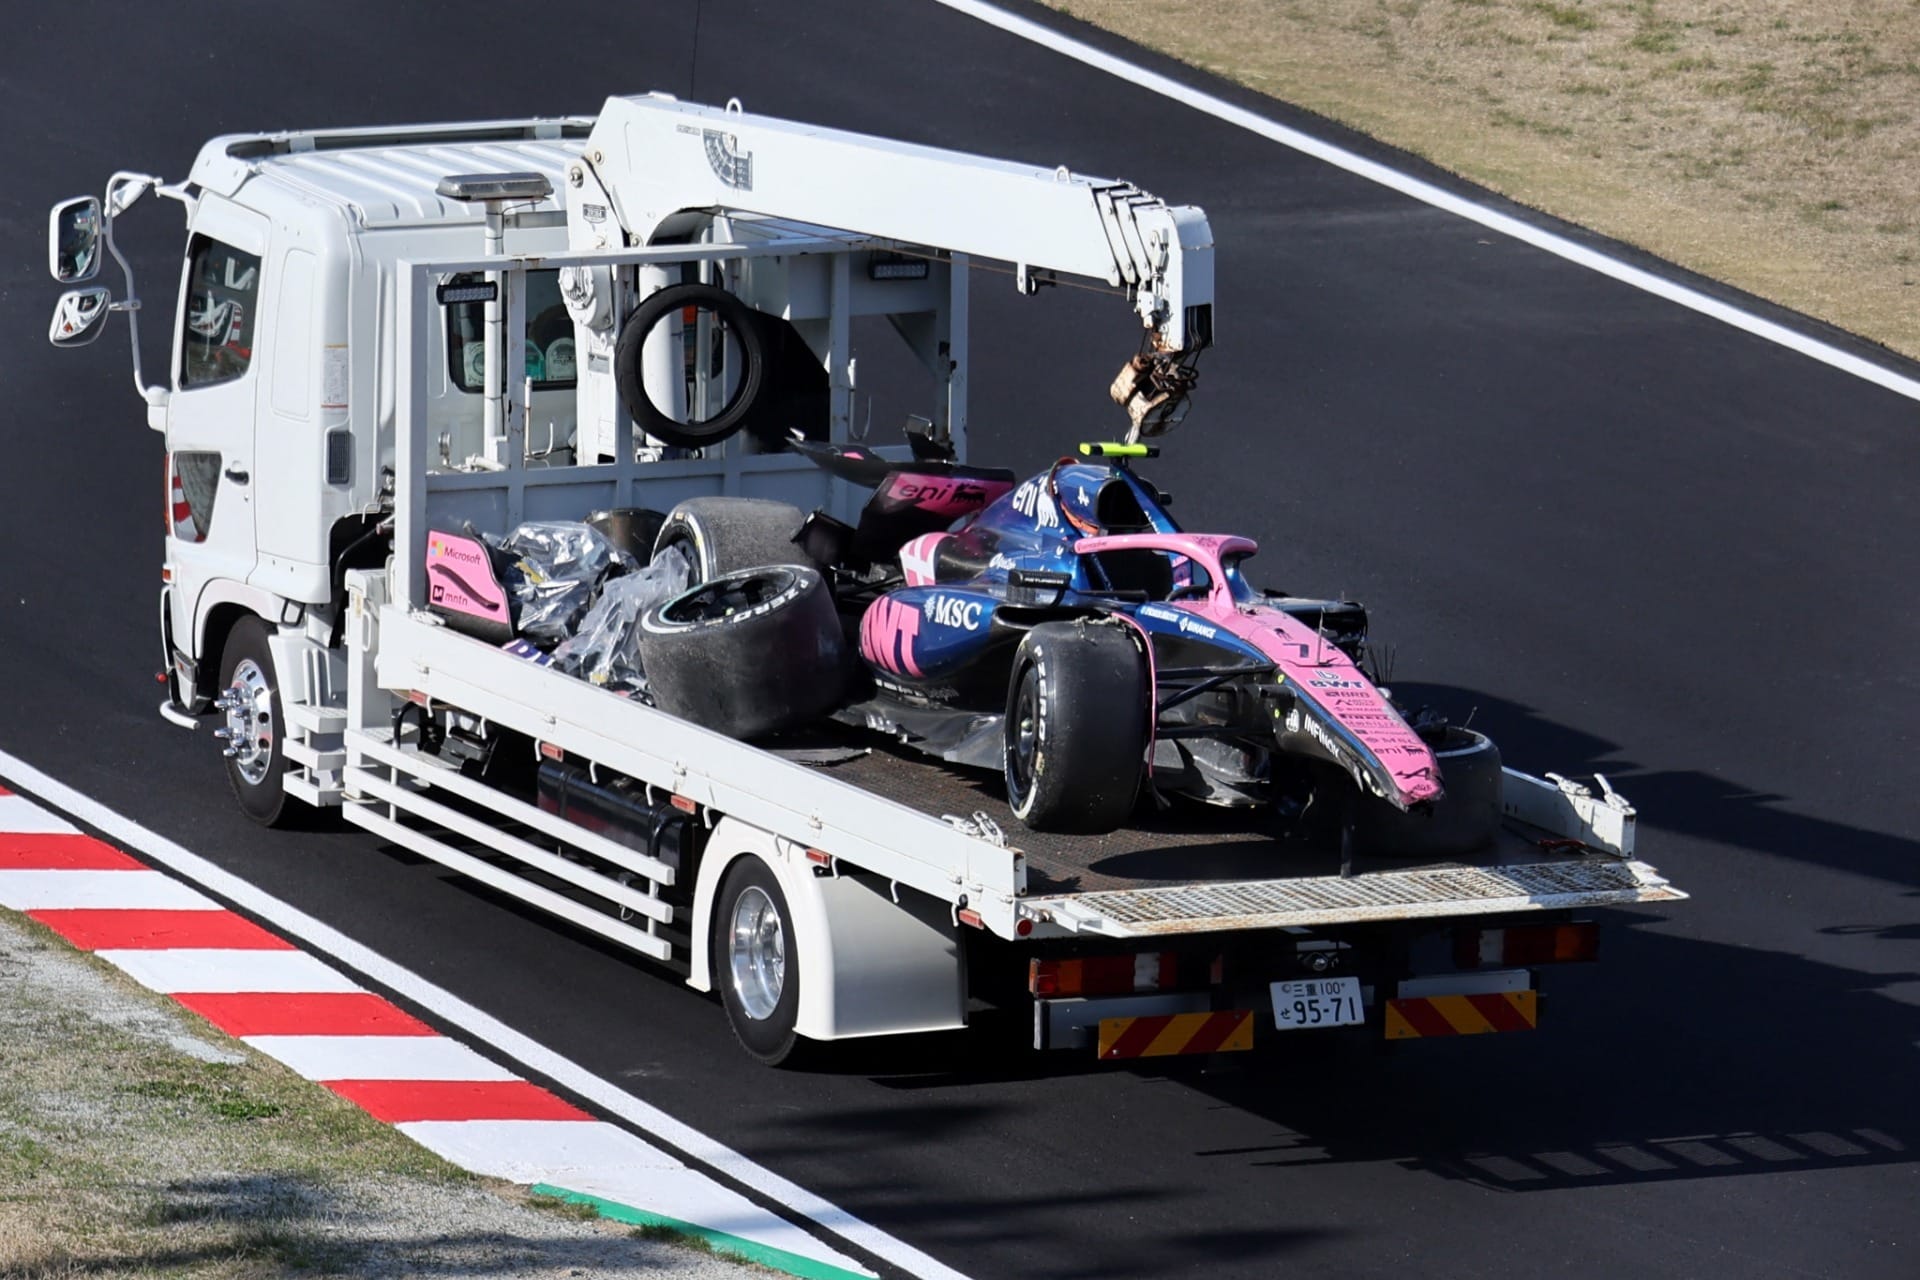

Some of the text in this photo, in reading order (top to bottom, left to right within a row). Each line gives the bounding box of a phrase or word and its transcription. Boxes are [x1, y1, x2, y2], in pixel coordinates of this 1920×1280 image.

[900, 483, 952, 500] eni
[1012, 480, 1038, 518] eni
[444, 546, 481, 566] Microsoft
[445, 592, 469, 606] mntn
[934, 595, 983, 631] MSC
[1304, 713, 1340, 758] INFINOX
[1373, 746, 1401, 755] eni
[1293, 982, 1341, 997] 三重 100
[1280, 997, 1356, 1025] せ 95-71
